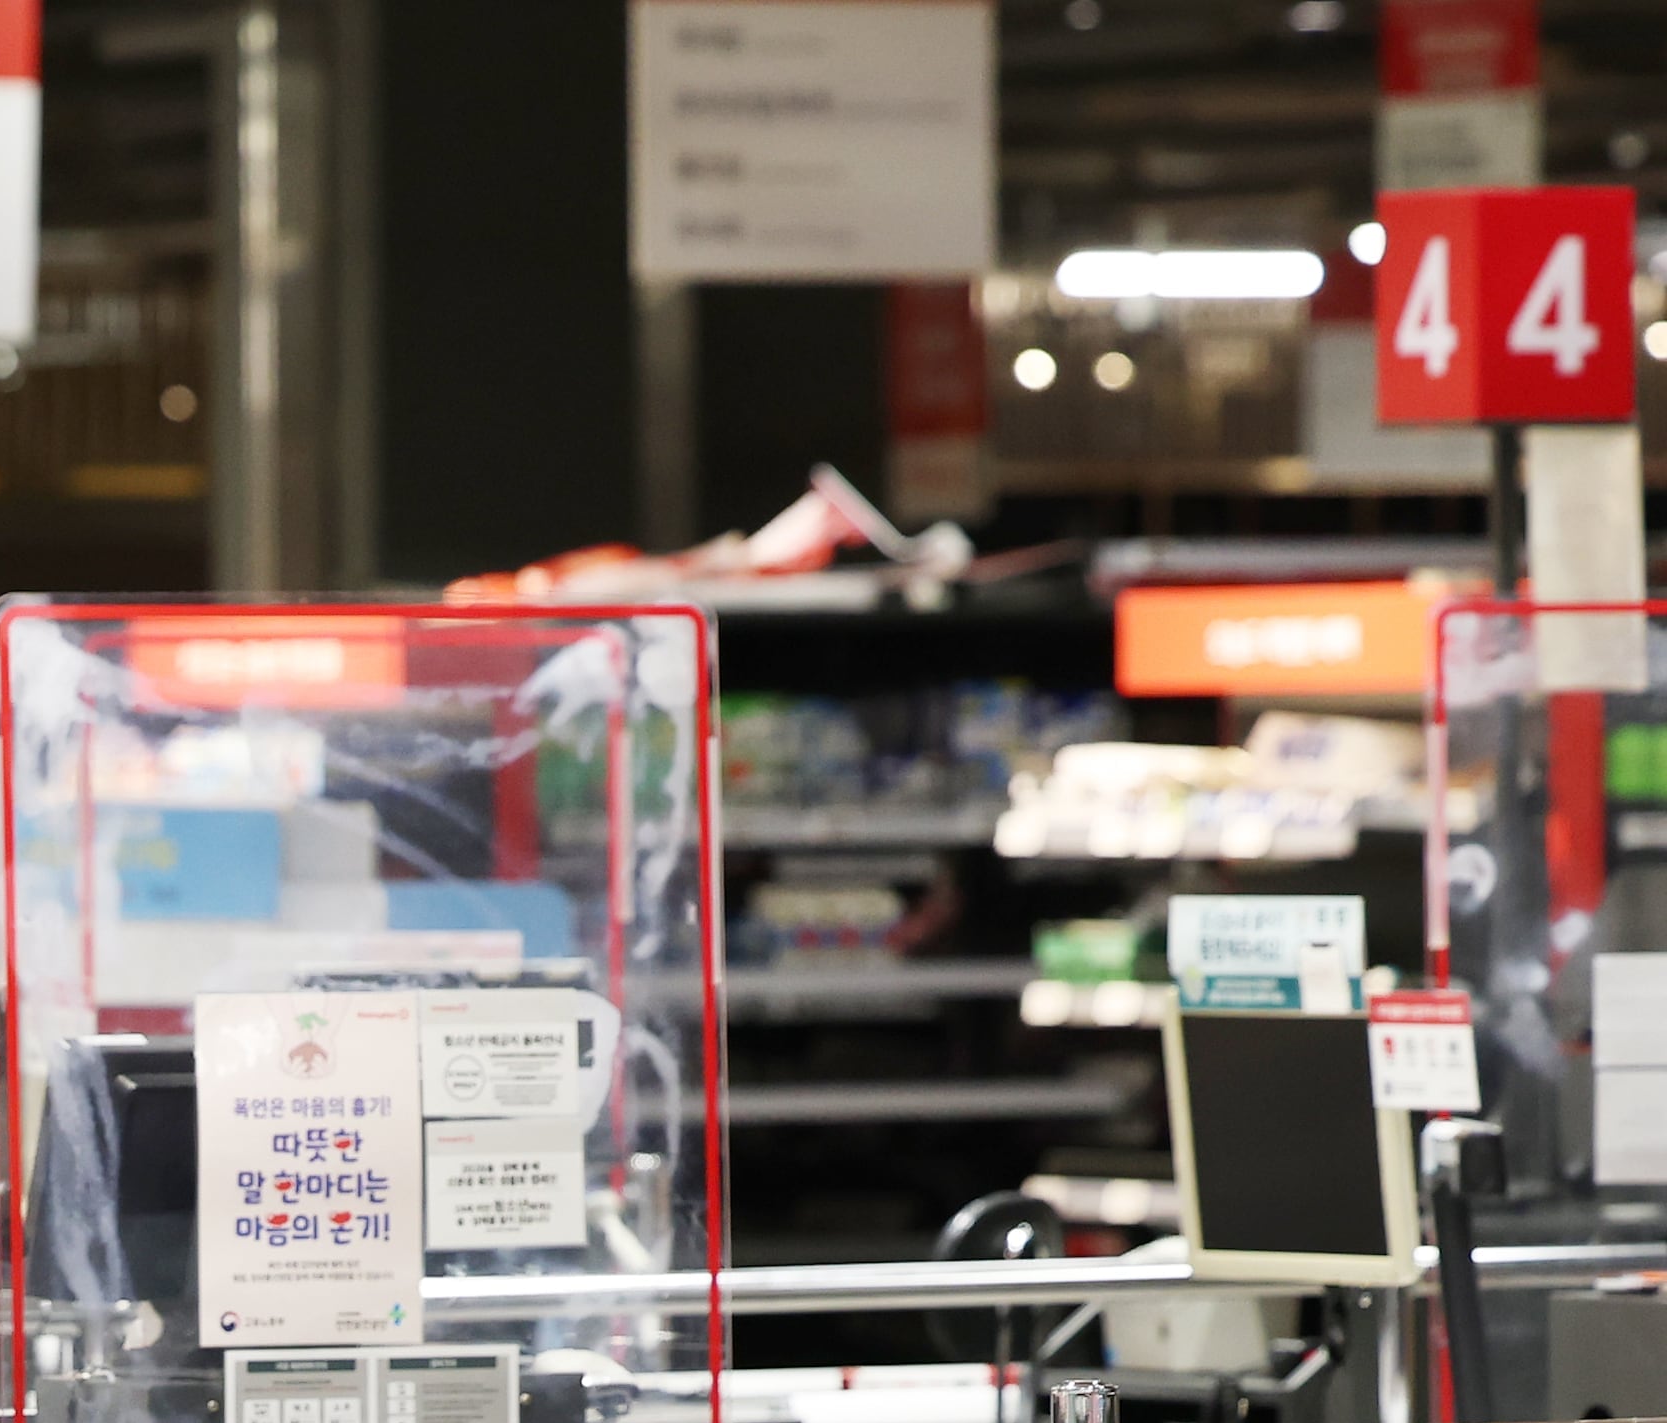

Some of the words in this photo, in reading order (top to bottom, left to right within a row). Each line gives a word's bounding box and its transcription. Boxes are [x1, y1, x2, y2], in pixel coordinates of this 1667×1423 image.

[1395, 236, 1458, 377] 4
[1508, 235, 1600, 377] 4
[273, 1128, 363, 1163] 따뜻한
[237, 1171, 265, 1205] 말
[274, 1169, 390, 1204] 한마디는
[235, 1212, 319, 1247] 마음의
[329, 1211, 391, 1245] 온기!
